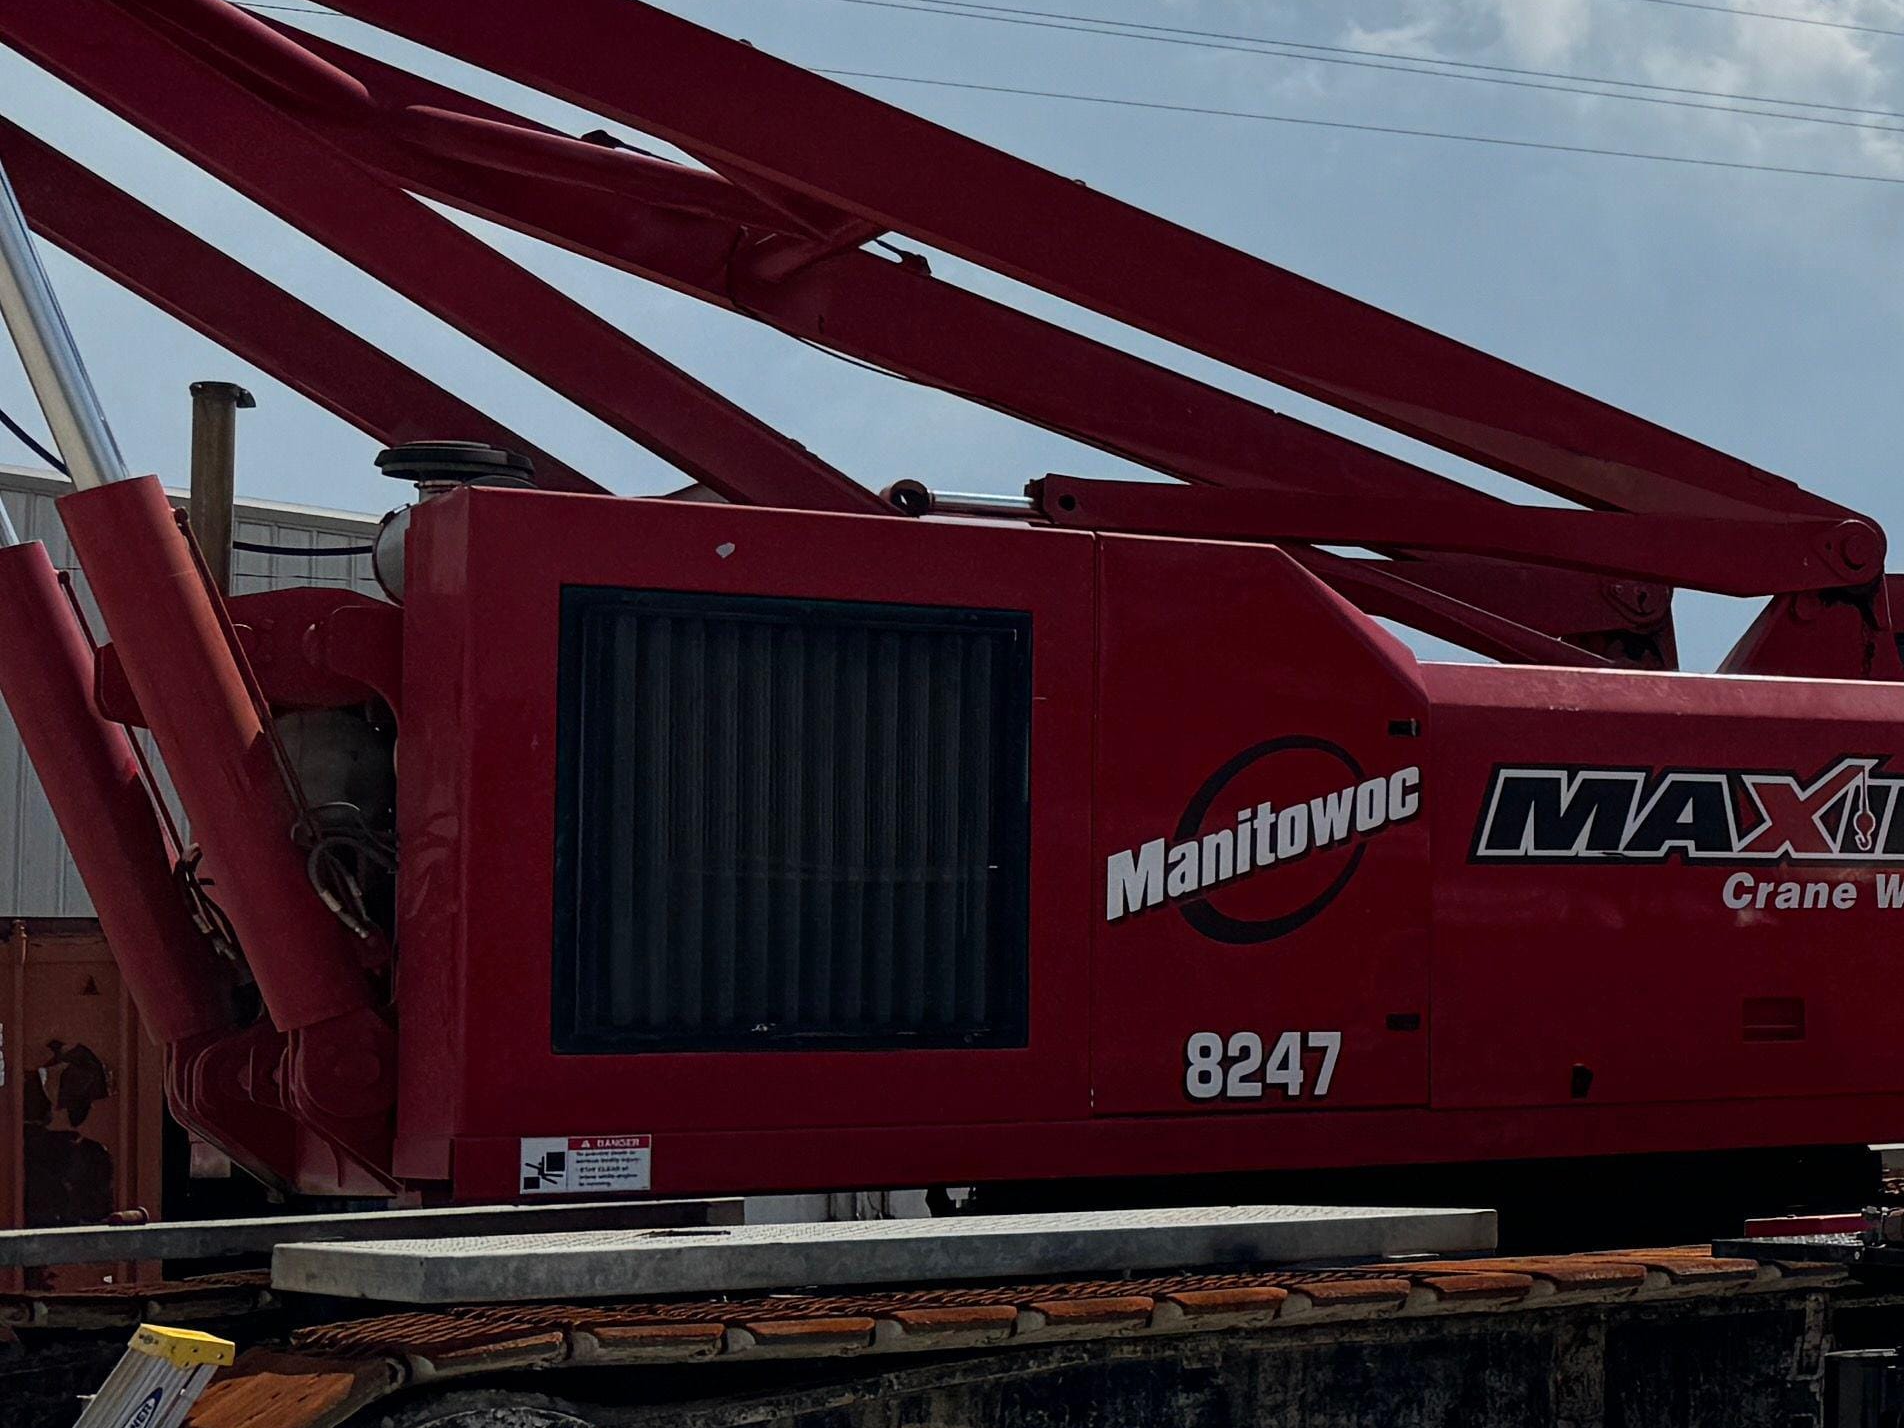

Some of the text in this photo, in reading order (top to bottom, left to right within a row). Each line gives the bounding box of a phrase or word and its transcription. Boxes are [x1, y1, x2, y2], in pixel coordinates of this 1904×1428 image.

[1106, 766, 1420, 921] Manitowoc
[1722, 872, 1857, 910] Crane
[1185, 1031, 1342, 1099] 8247
[597, 1138, 640, 1148] DANGER
